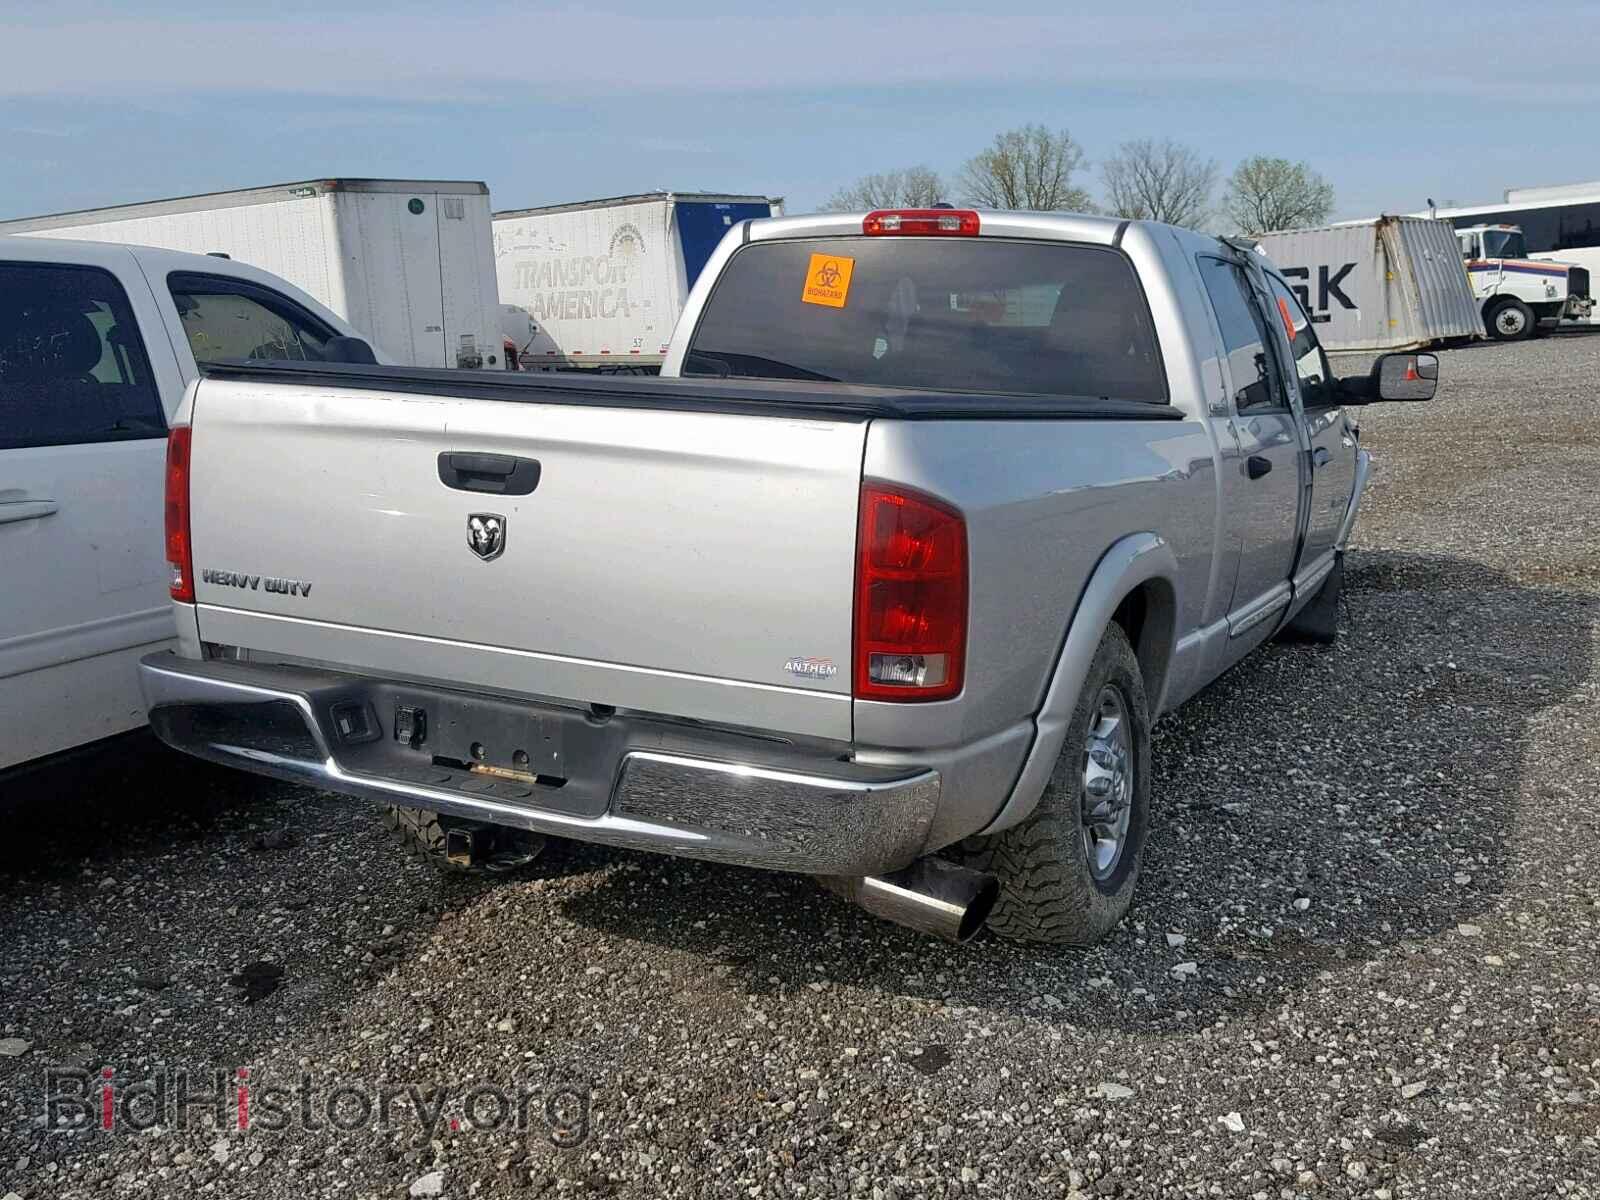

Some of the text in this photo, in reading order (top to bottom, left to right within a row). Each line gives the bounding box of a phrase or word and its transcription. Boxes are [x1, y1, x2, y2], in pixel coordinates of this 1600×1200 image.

[528, 287, 630, 320] AMERICA
[202, 568, 312, 597] HEAVY DUTY
[783, 660, 838, 674] ANTHEM
